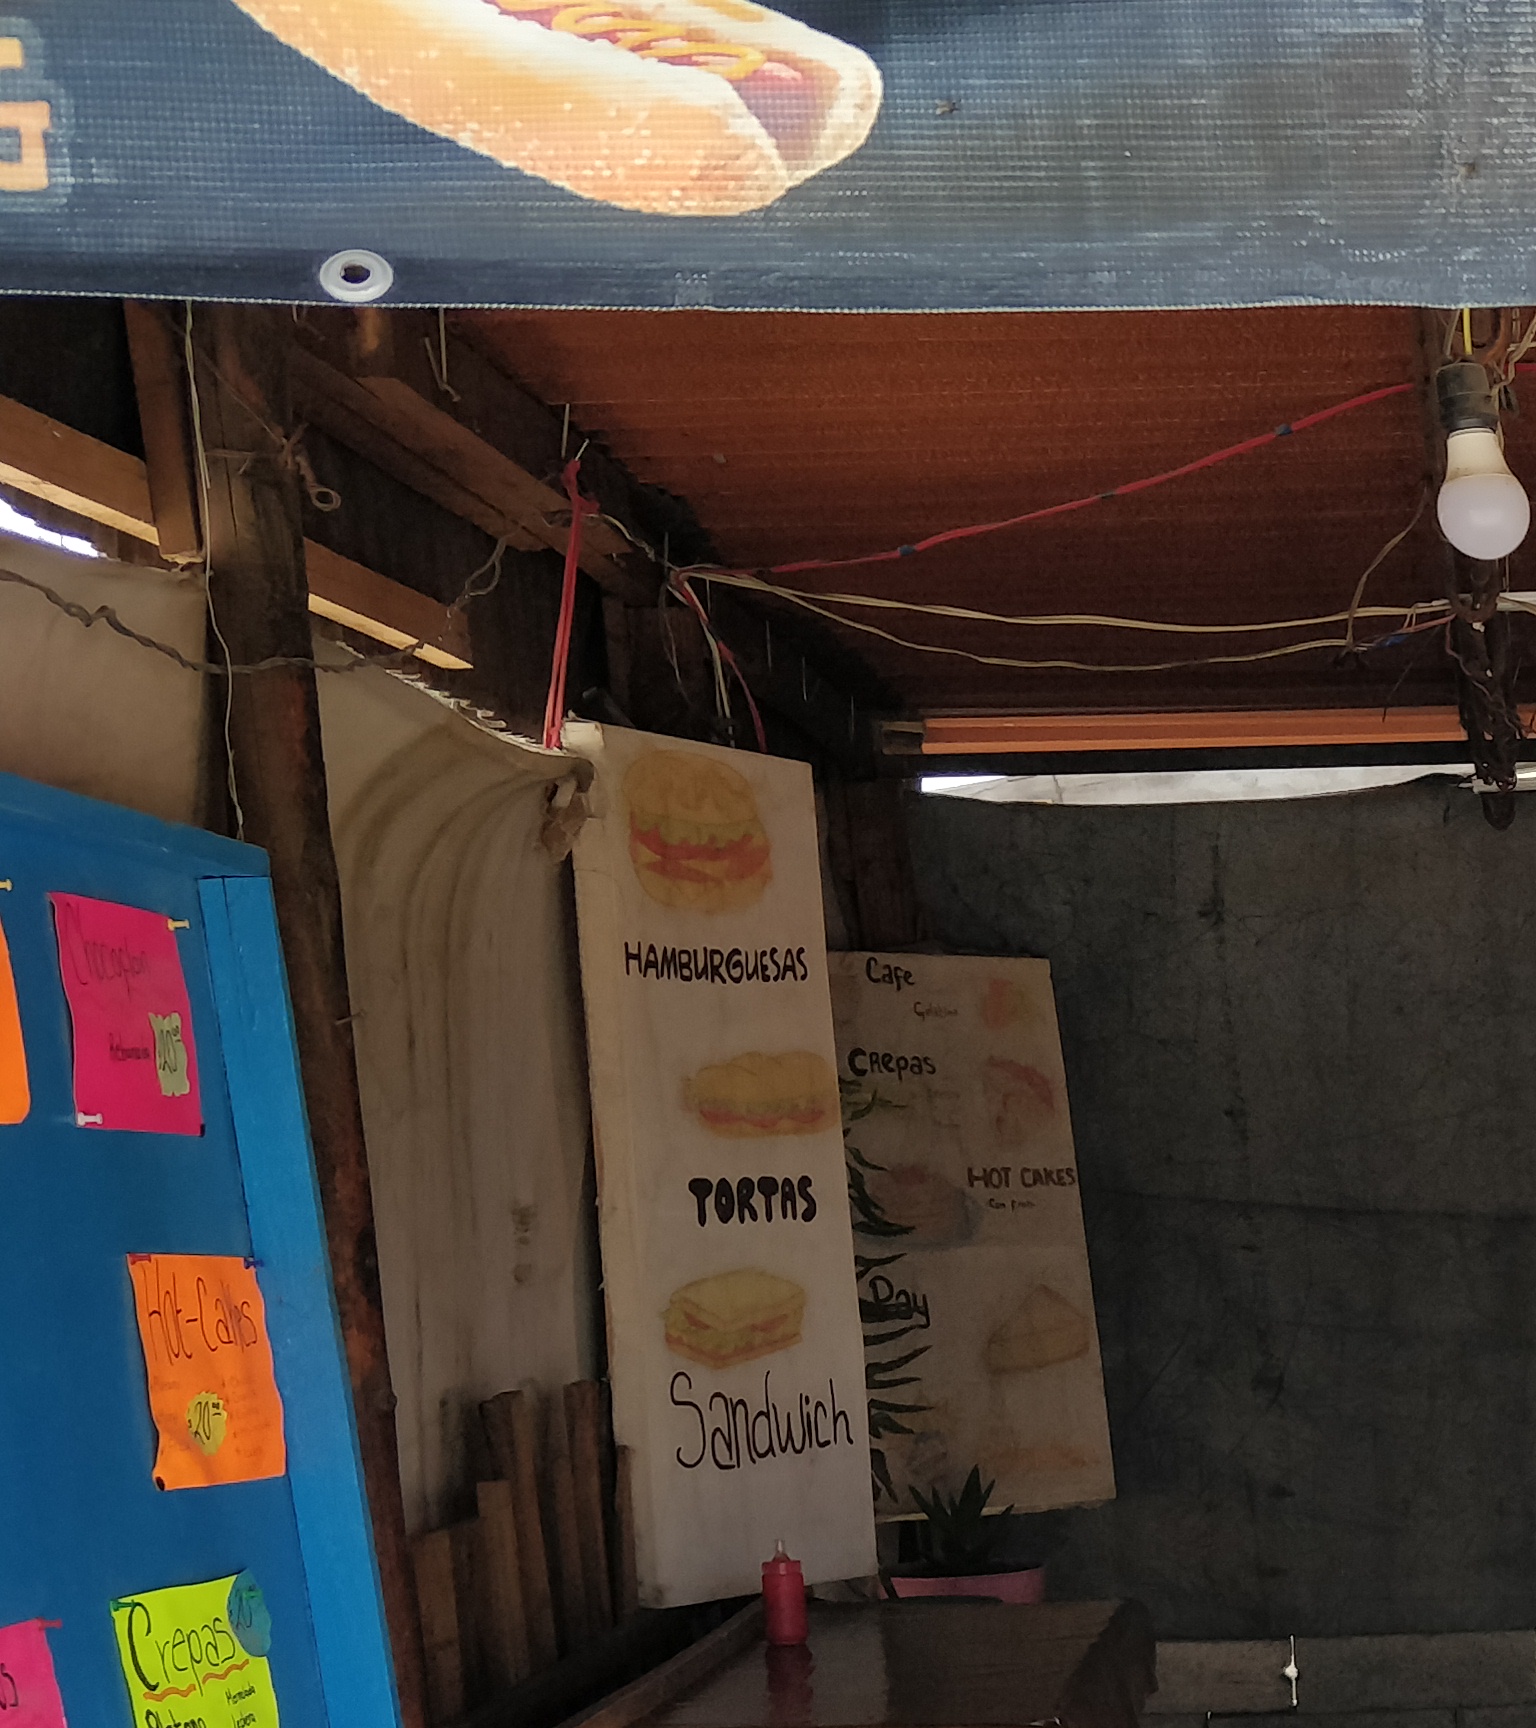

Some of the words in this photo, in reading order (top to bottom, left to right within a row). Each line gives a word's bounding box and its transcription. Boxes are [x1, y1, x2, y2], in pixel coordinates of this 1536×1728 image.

[622, 940, 809, 986] HAMBURGUESAS
[865, 956, 915, 992] Cafe
[688, 1173, 818, 1227] TORTAS
[967, 1166, 1012, 1189] HOT
[1020, 1166, 1078, 1187] CAKES
[668, 1370, 855, 1471] Sandwich
[127, 1601, 237, 1697] Crepas
